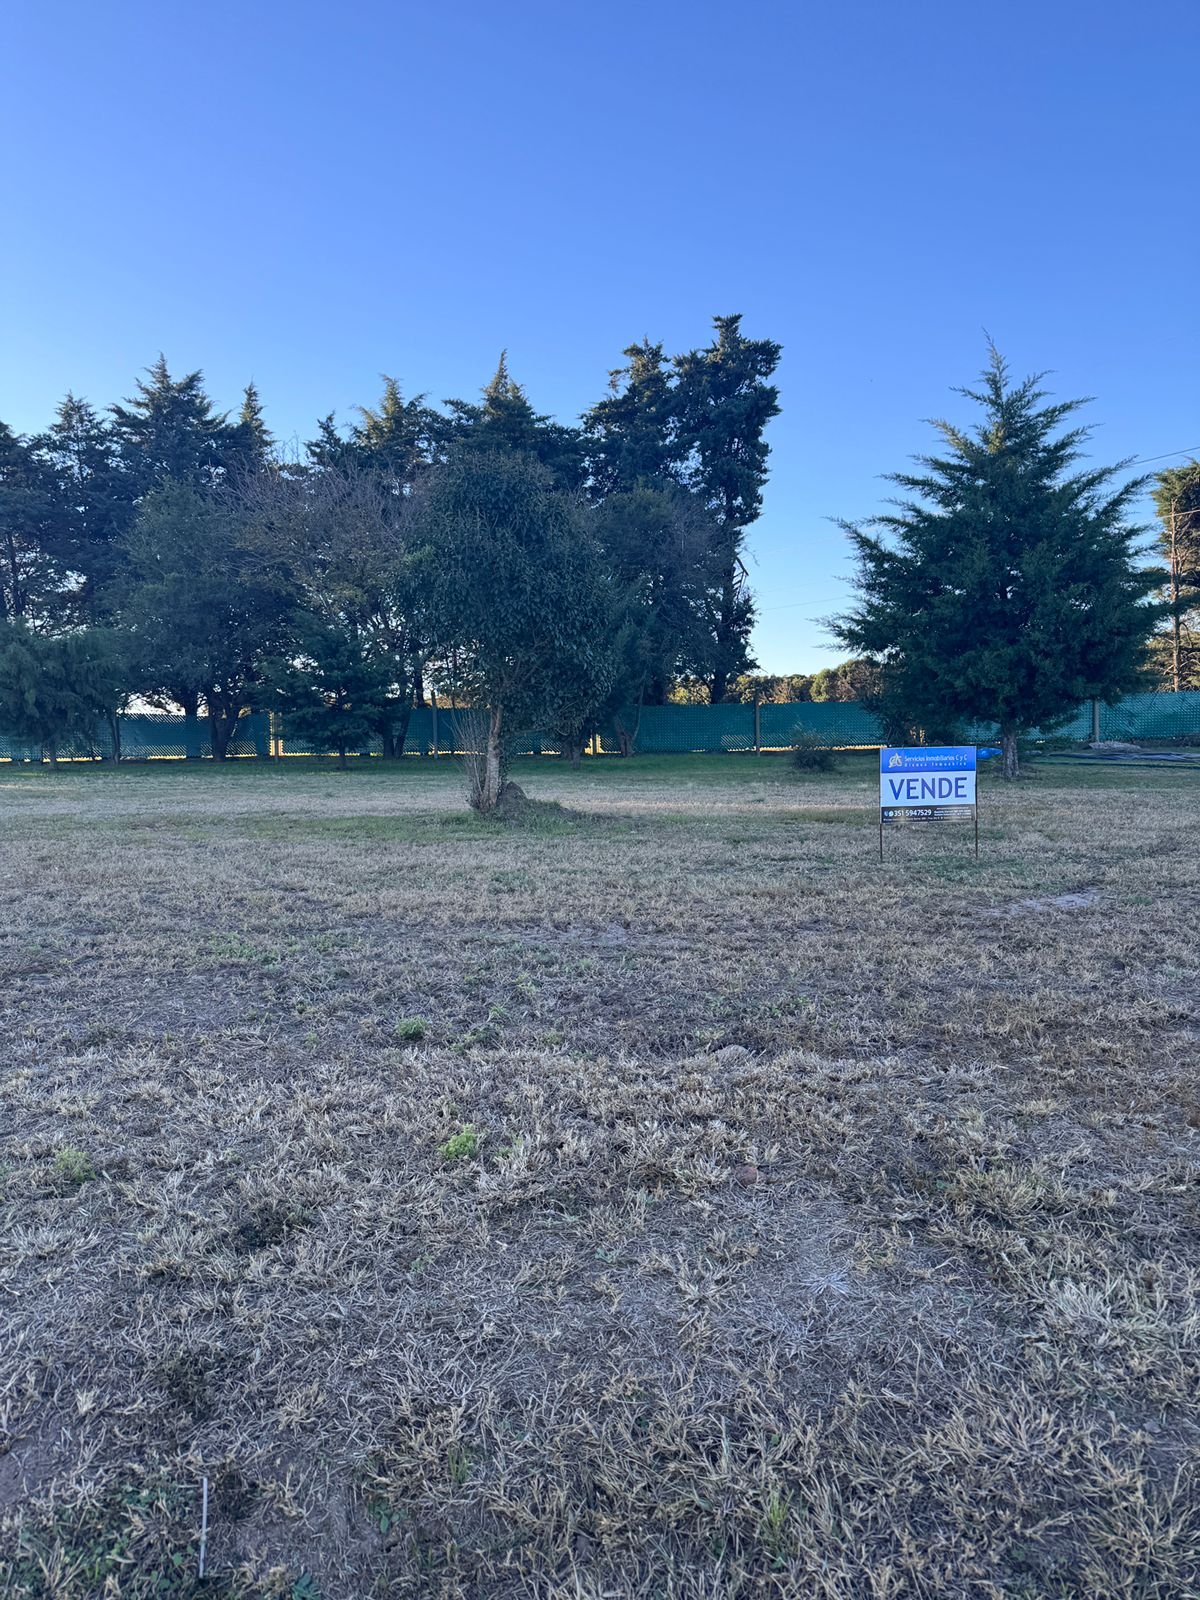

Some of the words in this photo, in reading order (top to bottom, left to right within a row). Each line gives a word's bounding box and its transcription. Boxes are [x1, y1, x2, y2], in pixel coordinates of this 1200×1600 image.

[888, 777, 967, 800] VENDE
[894, 809, 904, 817] 351
[905, 809, 932, 817] 5947529
